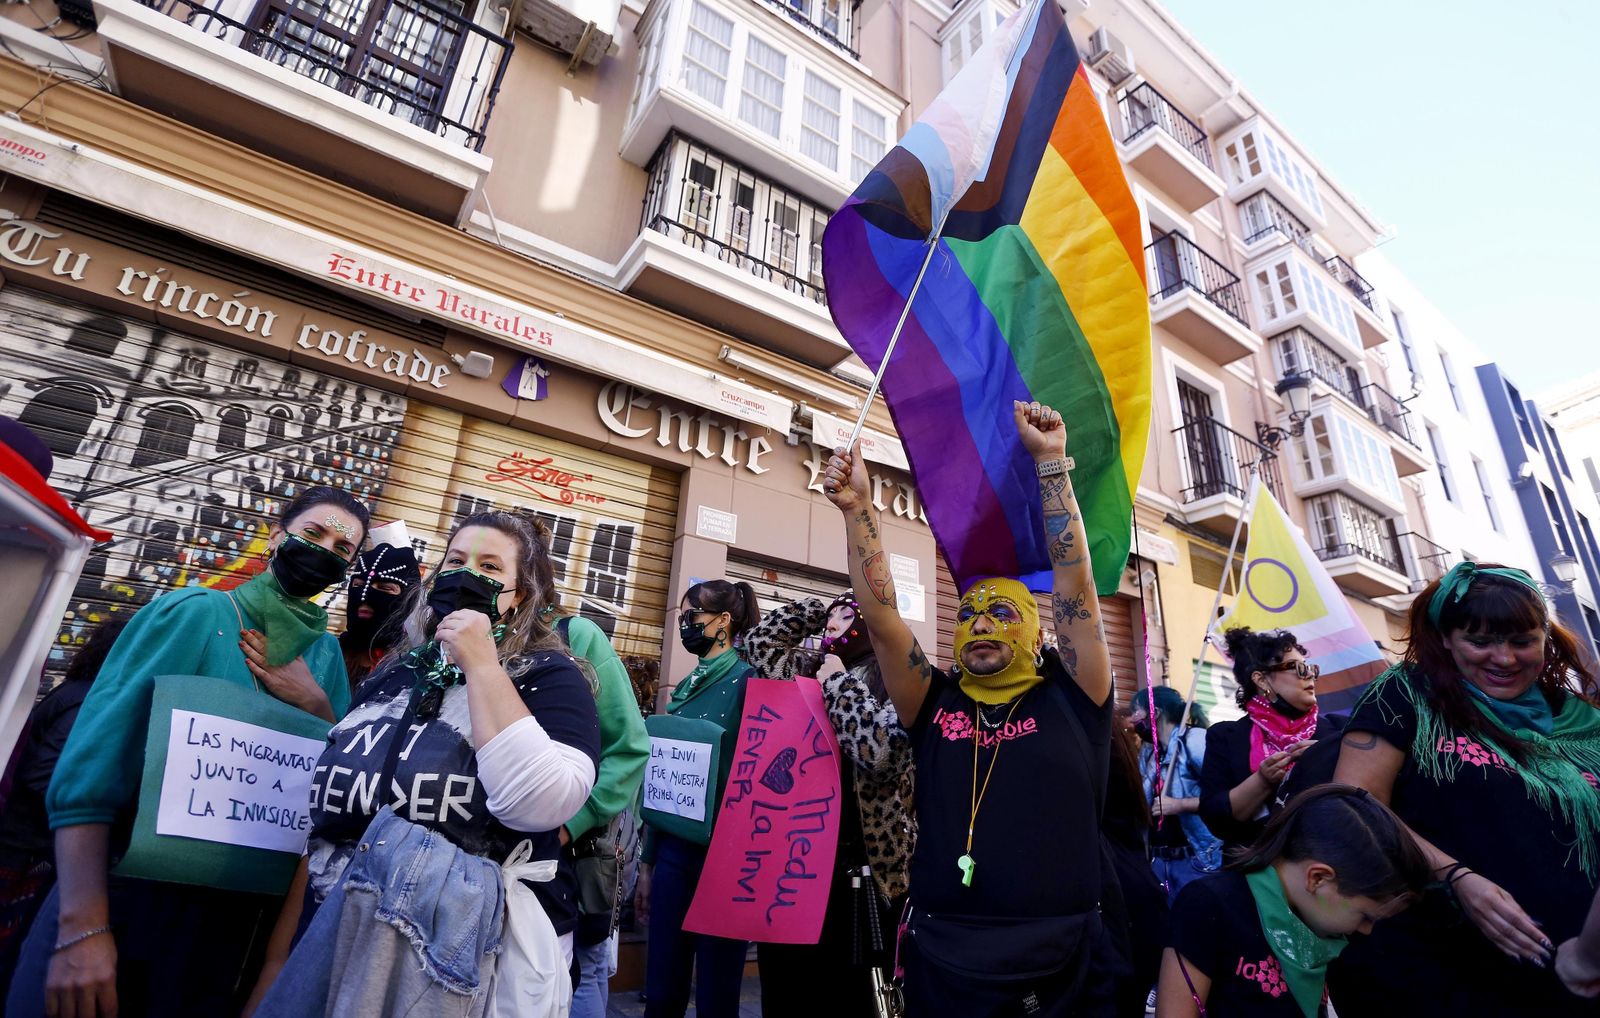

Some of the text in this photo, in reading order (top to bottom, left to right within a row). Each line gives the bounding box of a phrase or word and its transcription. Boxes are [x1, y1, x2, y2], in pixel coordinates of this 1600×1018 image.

[0, 220, 450, 389] Tu rincón cofrade
[328, 253, 553, 346] Entre Varales
[721, 390, 766, 411] Cruzcampo
[598, 381, 773, 475] Entre
[651, 743, 664, 759] LA
[272, 779, 284, 793] A
[651, 765, 704, 788] FUE NUESTRA
[188, 788, 215, 817] LA
[676, 793, 695, 808] CASA
